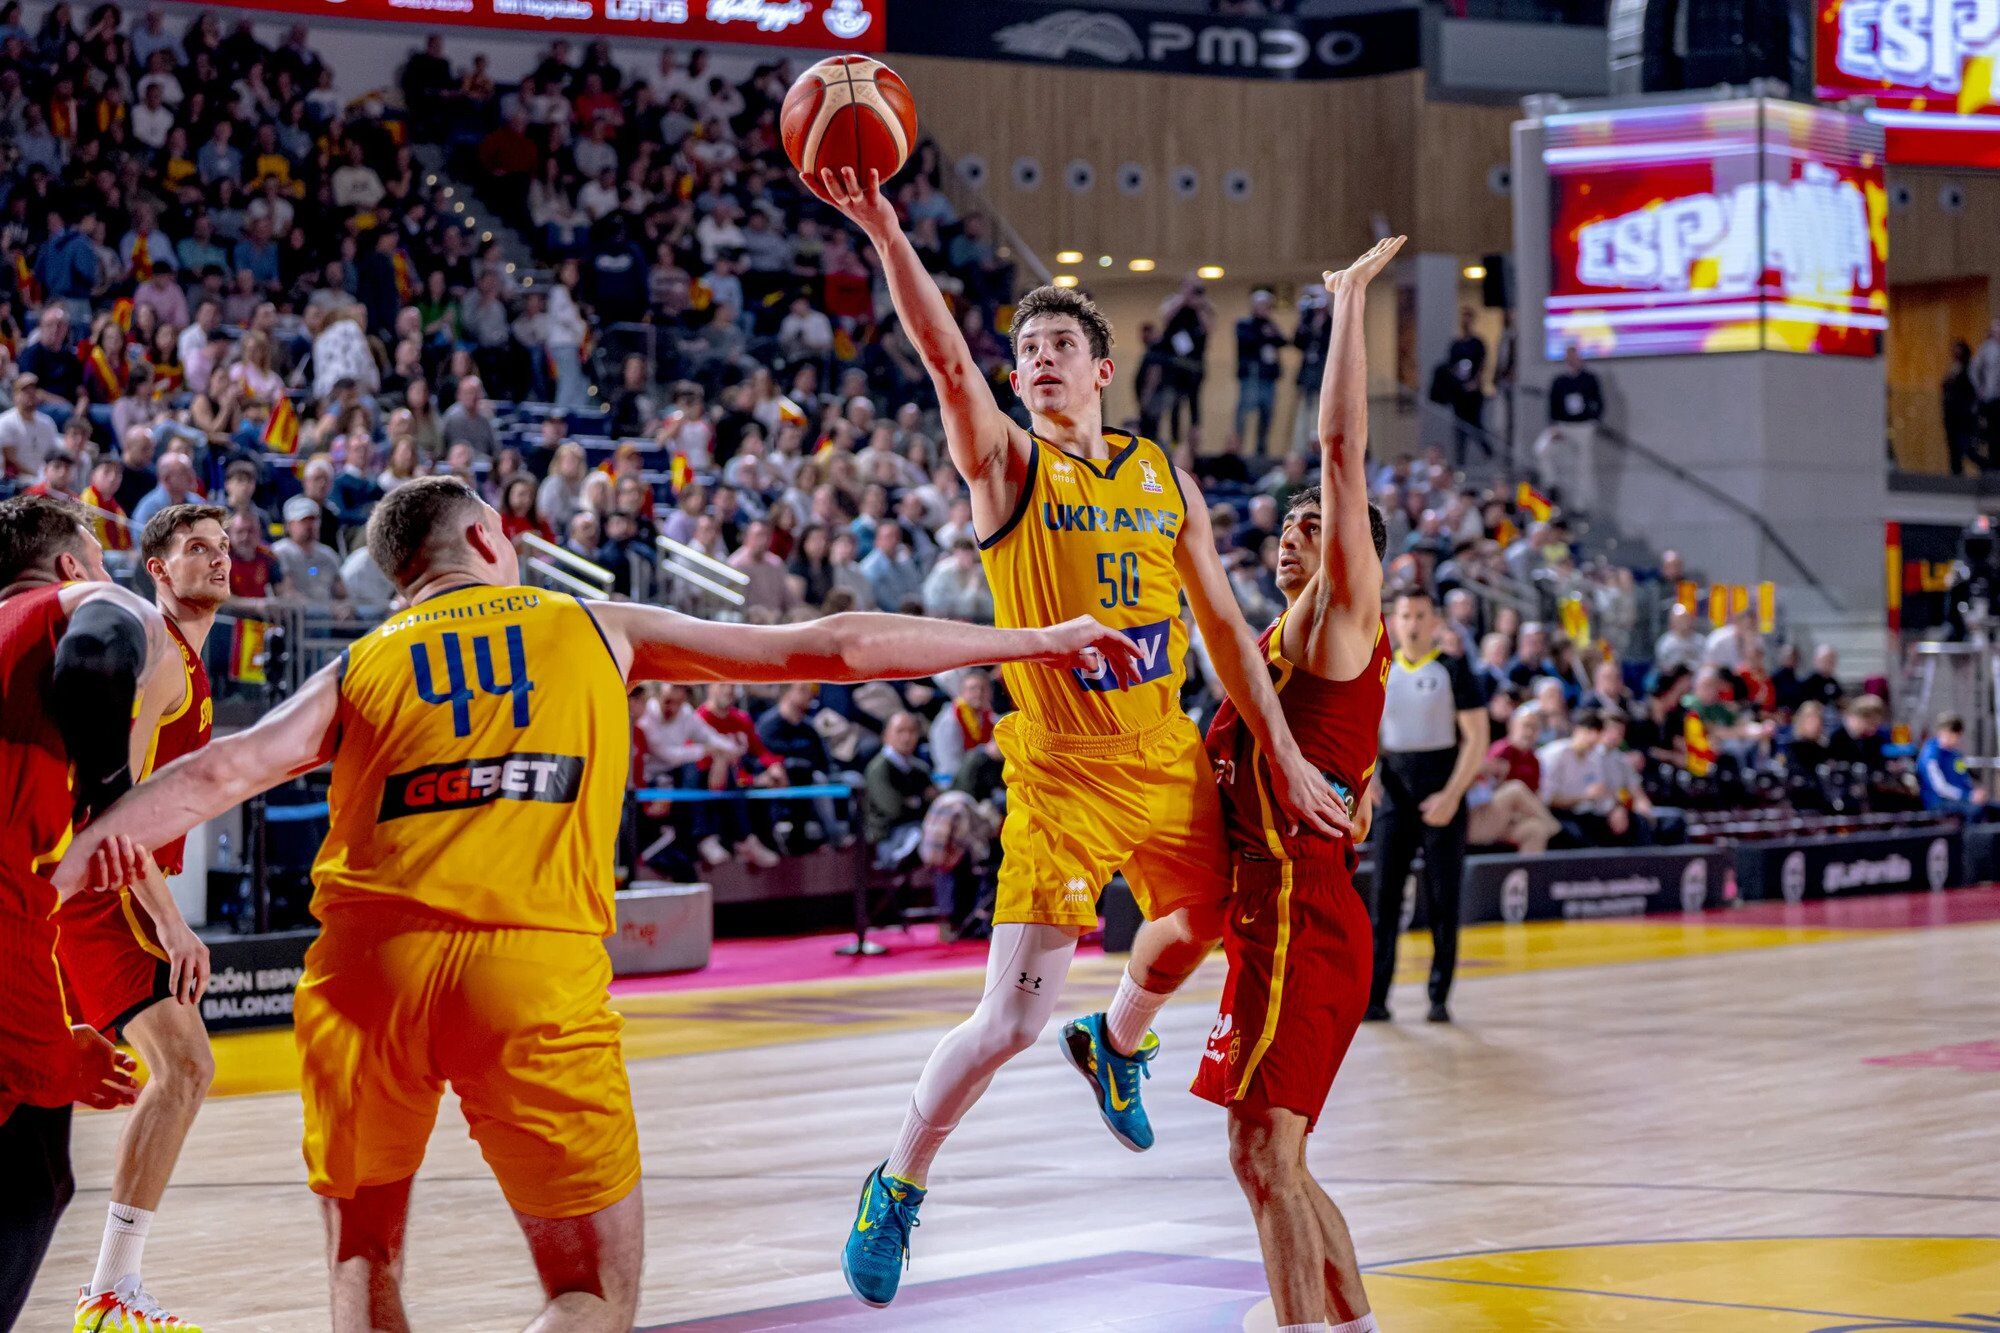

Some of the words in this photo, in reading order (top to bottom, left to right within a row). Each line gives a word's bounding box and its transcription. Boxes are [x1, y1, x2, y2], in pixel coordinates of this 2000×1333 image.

[1836, 0, 2000, 94] ESP
[1043, 502, 1179, 539] UKRAINE
[1096, 552, 1140, 608] 50
[410, 625, 534, 737] 44
[404, 760, 558, 806] GG.BET
